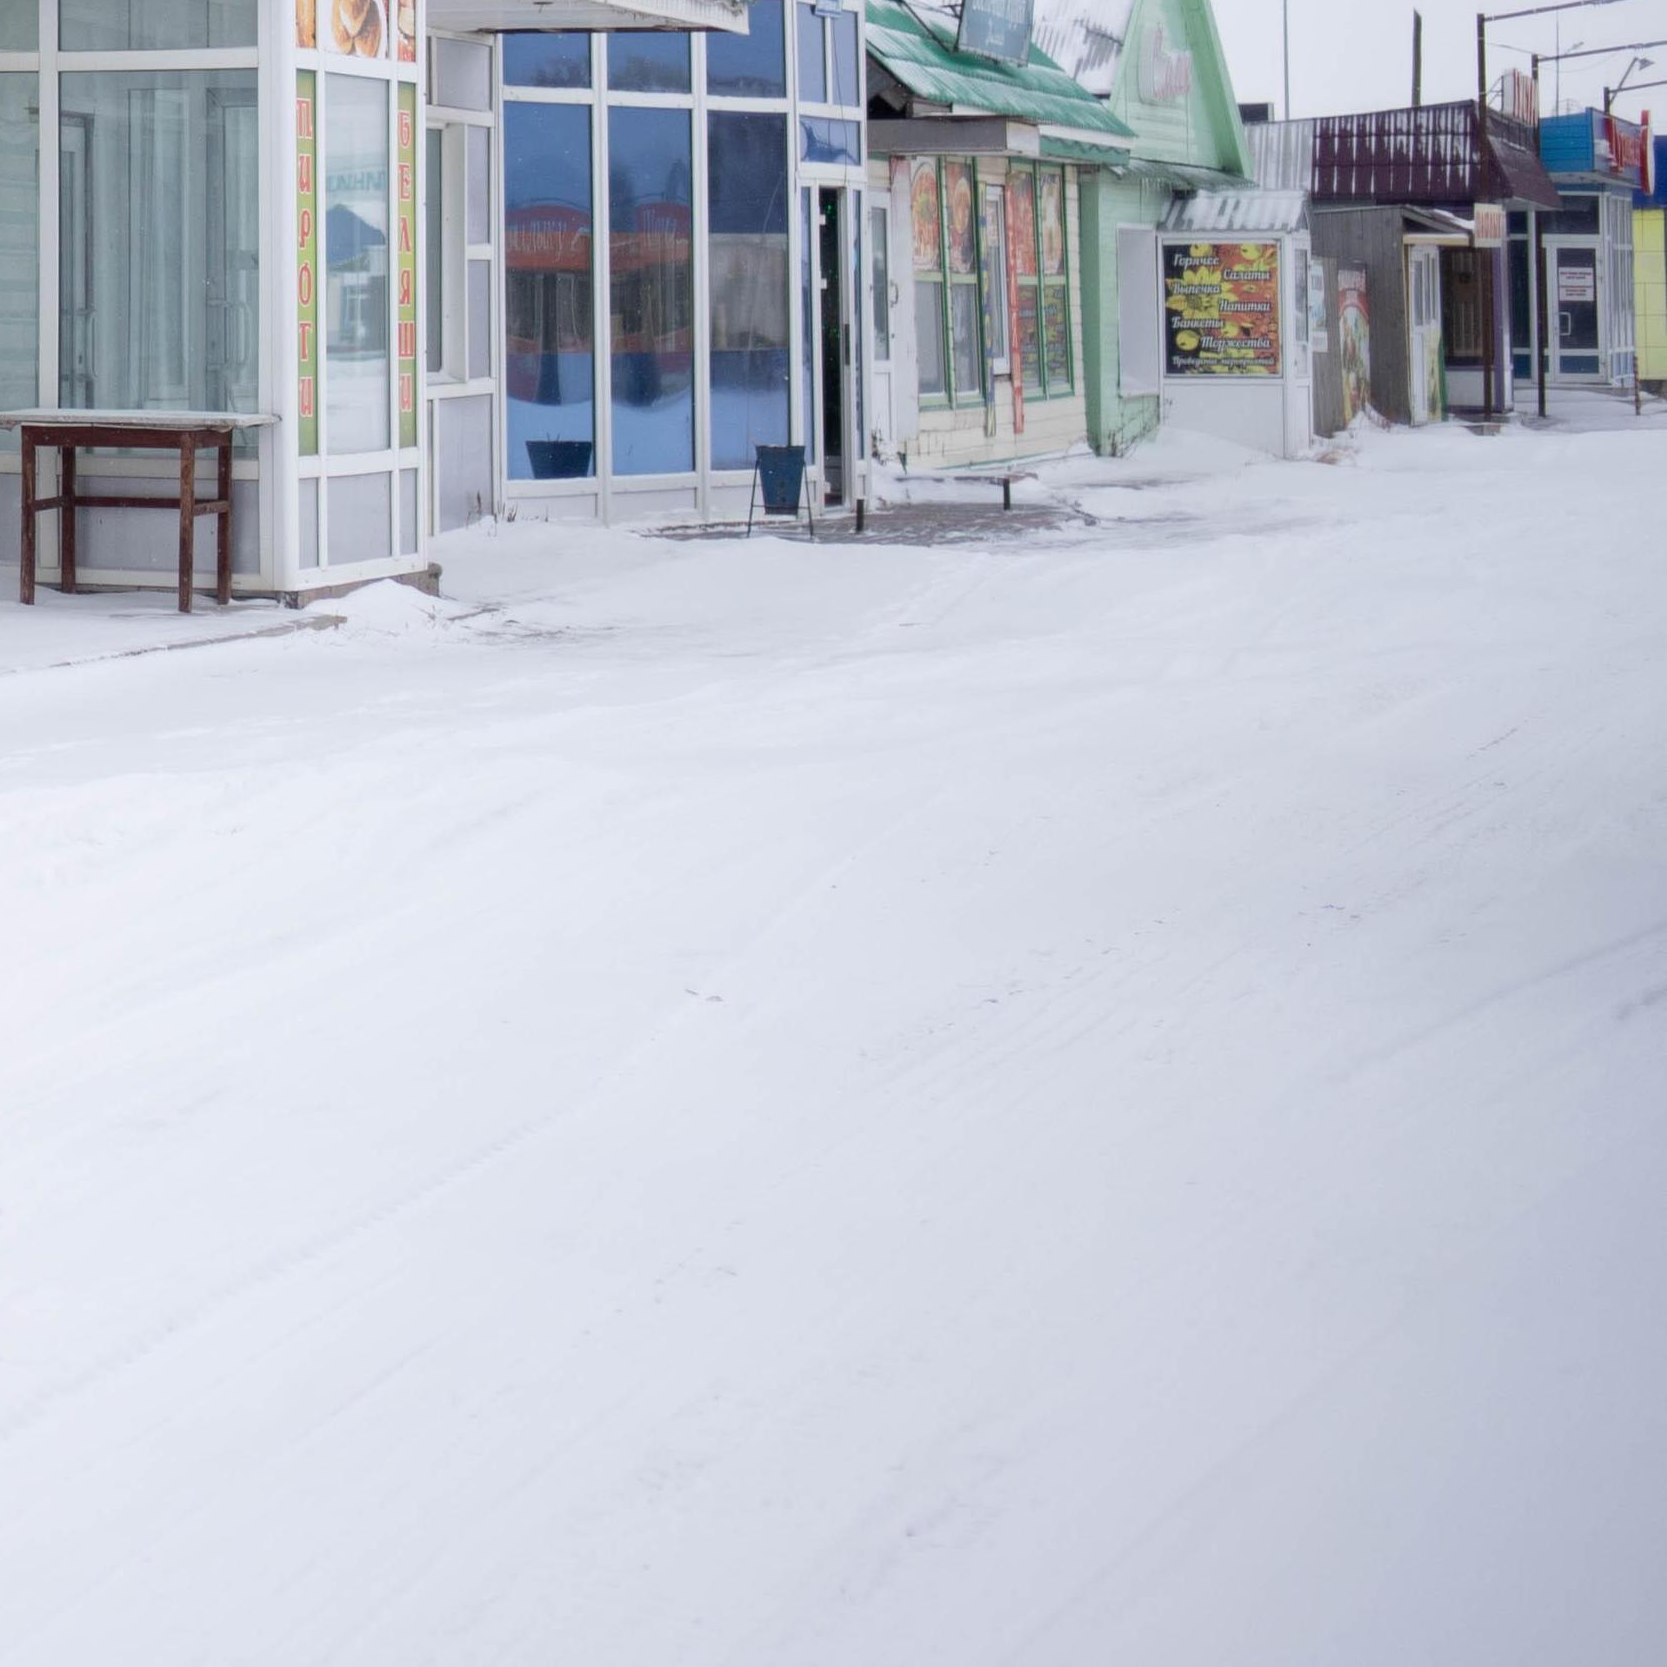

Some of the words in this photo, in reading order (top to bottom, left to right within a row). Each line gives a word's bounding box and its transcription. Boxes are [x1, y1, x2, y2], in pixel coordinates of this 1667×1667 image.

[397, 111, 415, 413] БЕЛЯШИ
[1173, 254, 1219, 269] Горячее
[1223, 269, 1271, 280] Салаты
[1173, 284, 1221, 294] Выпечка
[1219, 299, 1271, 311] Напитки
